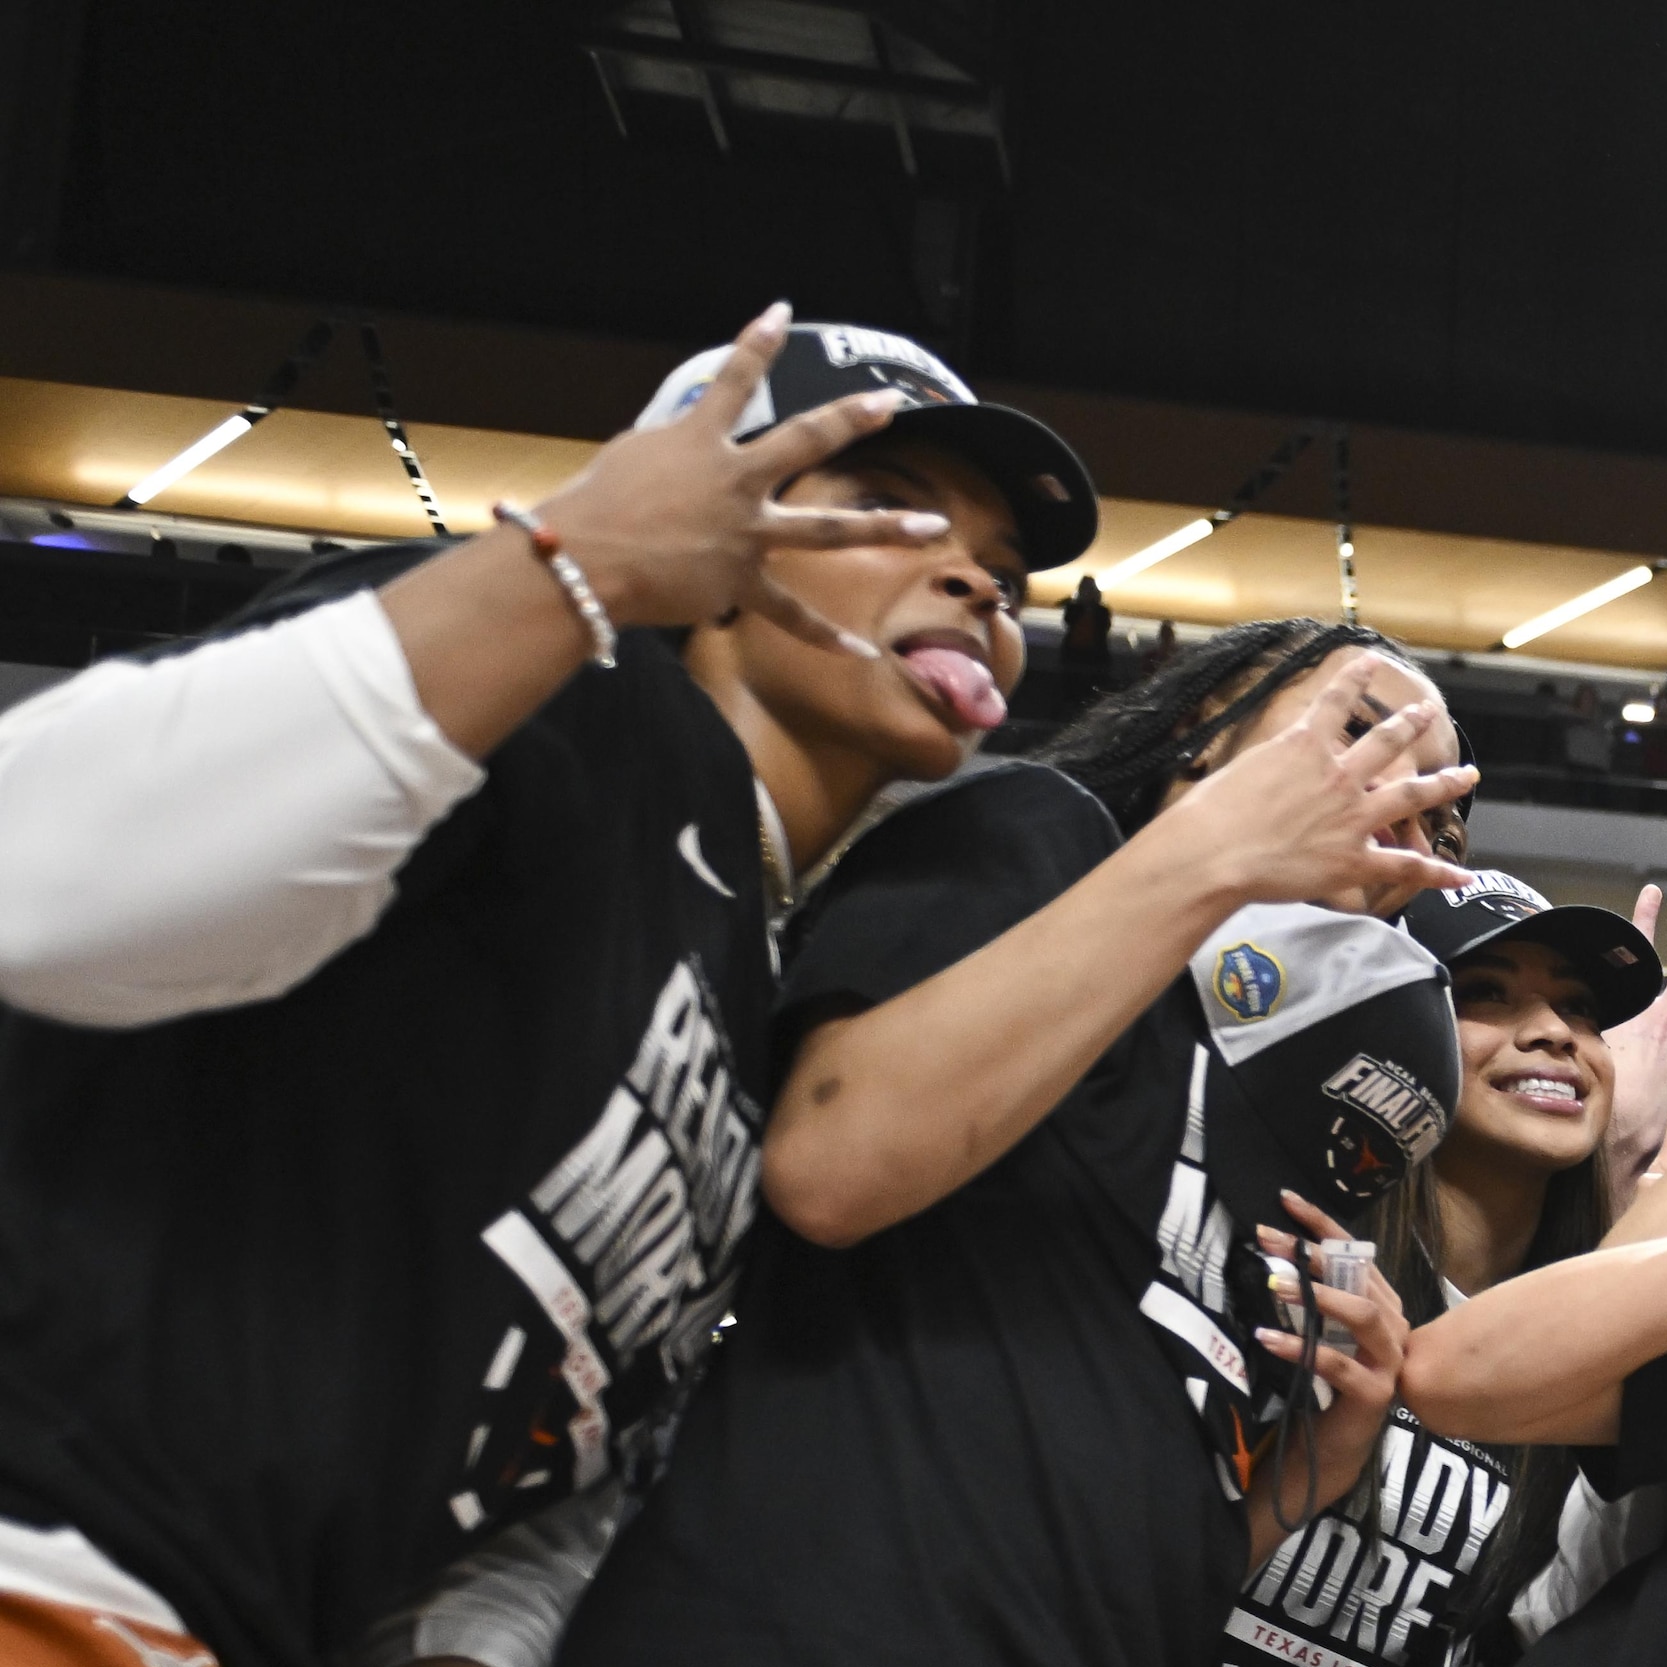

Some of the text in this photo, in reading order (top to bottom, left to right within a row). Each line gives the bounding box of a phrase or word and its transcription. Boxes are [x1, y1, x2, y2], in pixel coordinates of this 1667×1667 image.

[1326, 1057, 1424, 1132] FINAL
[1378, 1424, 1510, 1575] ADY
[1253, 1624, 1323, 1667] TEXAS
